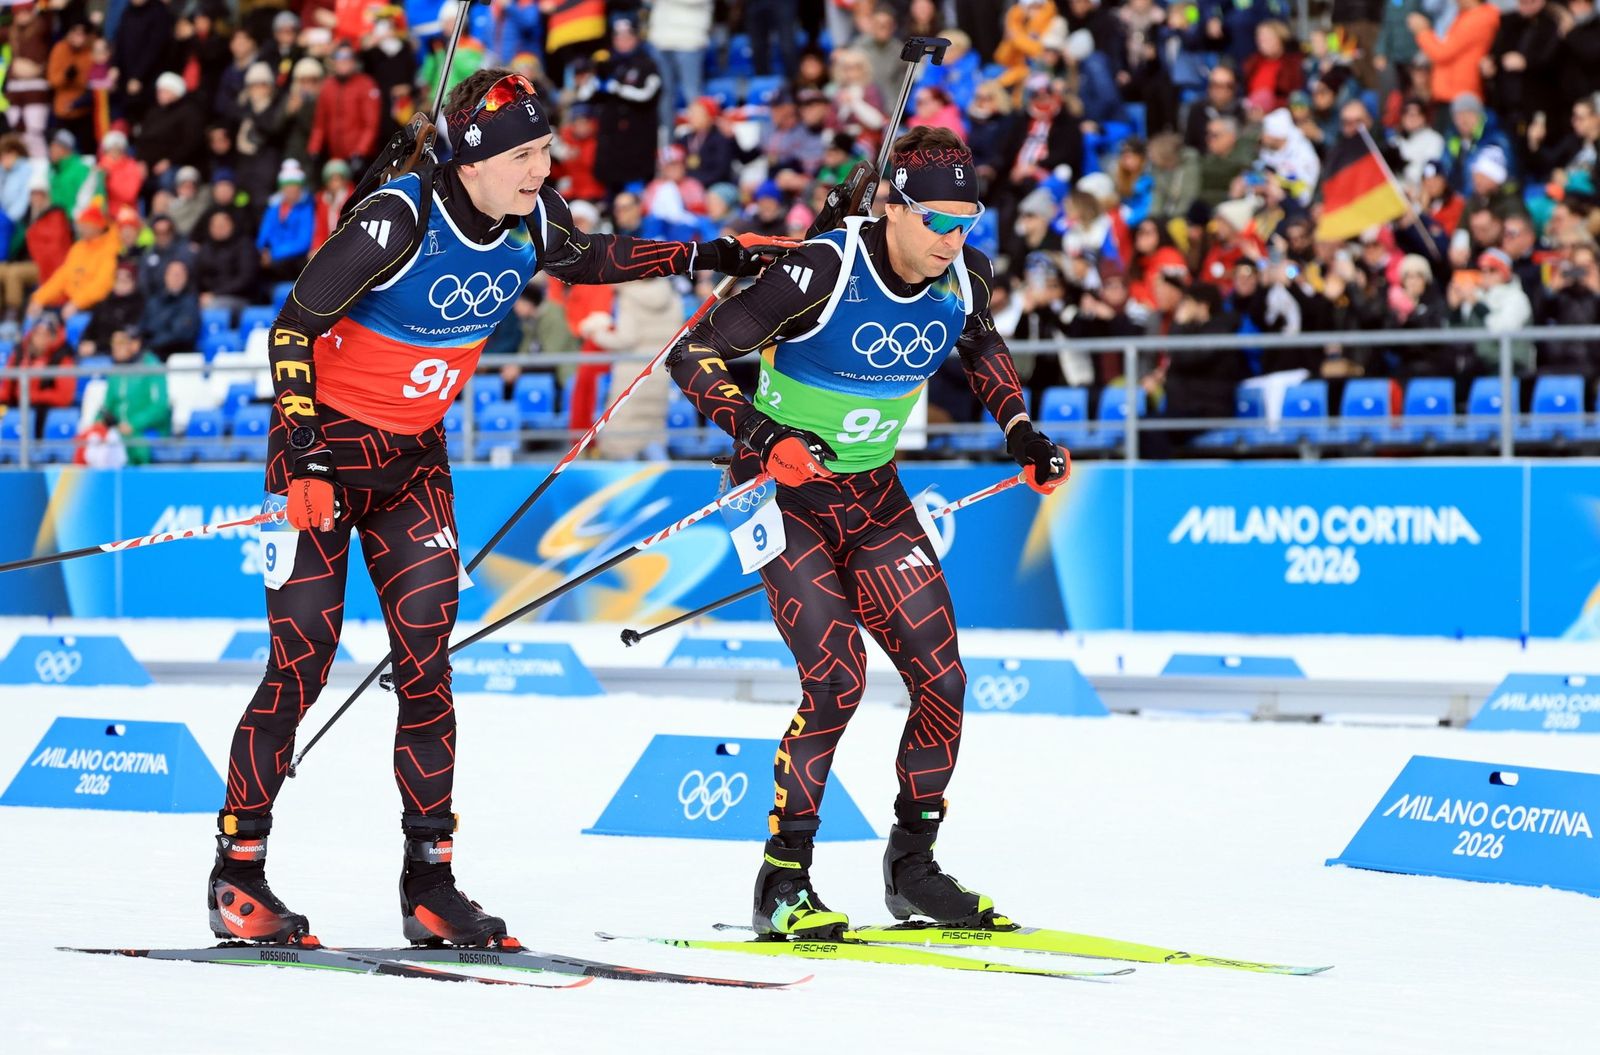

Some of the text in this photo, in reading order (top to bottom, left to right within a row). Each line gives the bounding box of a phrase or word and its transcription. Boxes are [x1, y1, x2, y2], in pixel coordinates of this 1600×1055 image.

[525, 104, 536, 116] D
[954, 168, 964, 179] D
[403, 323, 450, 335] MILANO
[274, 328, 316, 417] GER
[833, 371, 882, 382] MILANO
[884, 374, 925, 382] CORTINA
[836, 408, 899, 443] 92
[1168, 505, 1481, 544] MILANO CORTINA
[753, 523, 768, 551] 9
[265, 542, 277, 572] 9
[1284, 545, 1360, 584] 2026
[1490, 692, 1567, 712] MILANO
[31, 746, 169, 775] MILANO CORTINA
[74, 773, 112, 795] 2026
[1382, 793, 1593, 839] MILANO CORTINA
[231, 844, 265, 853] ROSSIGNOL
[1452, 830, 1506, 859] 2026
[941, 931, 992, 940] FISCHER
[260, 950, 301, 963] ROSSIGNOL
[792, 943, 838, 953] FISCHER
[459, 952, 502, 966] ROSSIGNOL
